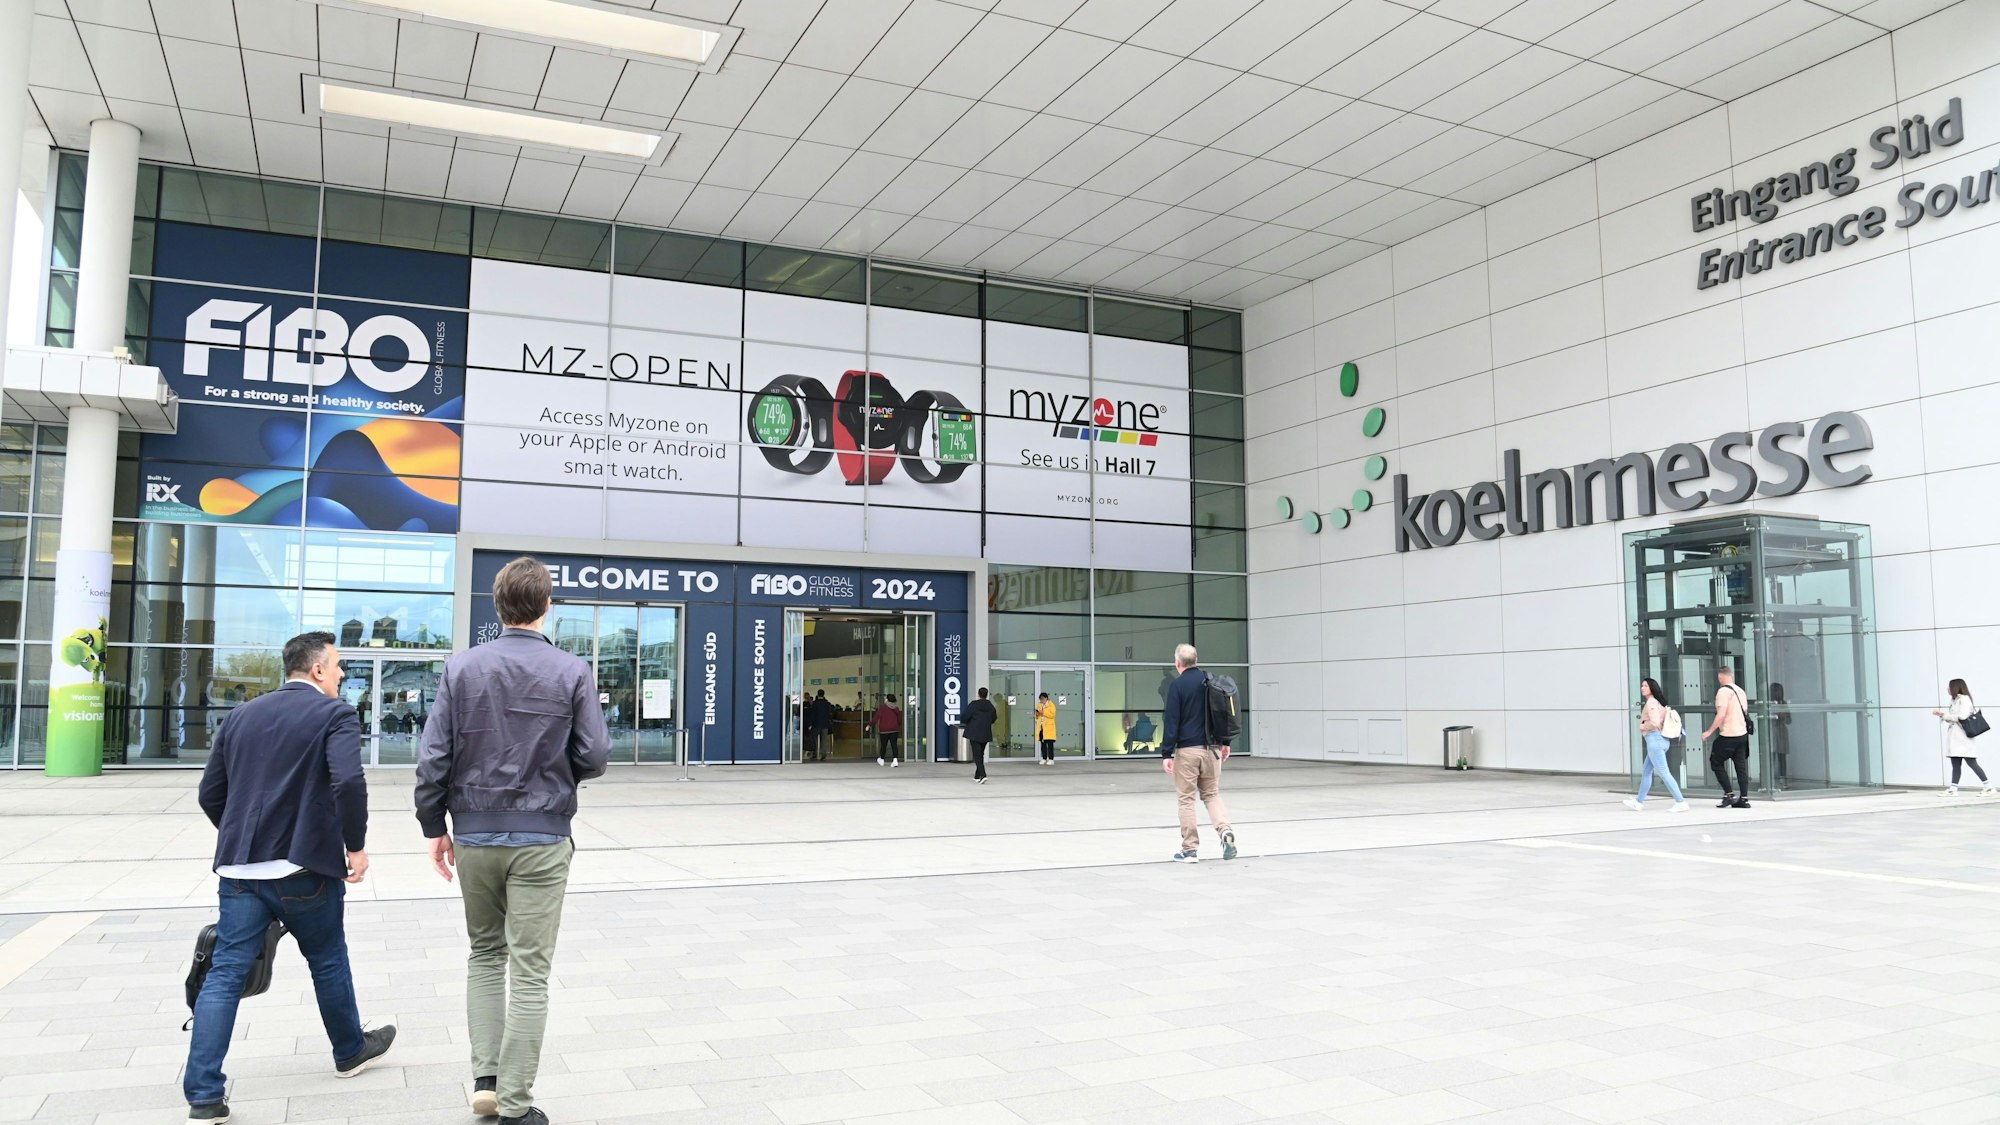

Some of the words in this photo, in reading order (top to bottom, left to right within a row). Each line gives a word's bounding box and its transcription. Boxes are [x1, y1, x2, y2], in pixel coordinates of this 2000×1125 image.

[1691, 148, 1859, 233] Eingang
[1870, 97, 1964, 170] Süd
[1697, 206, 1886, 290] Entrance
[183, 299, 431, 393] FIBO
[435, 321, 446, 357] FITNESS
[434, 358, 444, 395] GLOBAL
[521, 342, 731, 390] MZ-OPEN
[204, 385, 227, 397] For
[231, 388, 240, 399] a
[243, 390, 288, 404] strong
[292, 394, 319, 405] and
[322, 396, 373, 411] healthy
[376, 401, 425, 413] society.
[539, 407, 603, 427] Access
[609, 412, 680, 434] Myzone
[685, 422, 709, 434] on
[763, 403, 786, 425] 74%
[519, 432, 564, 449] your
[569, 433, 622, 455] Apple
[628, 440, 648, 452] or
[653, 440, 727, 459] Android
[948, 432, 967, 451] 74%
[623, 464, 683, 481] watch.
[1021, 448, 1053, 468] See
[1059, 454, 1079, 470] us
[1105, 456, 1140, 475] Hall
[1146, 460, 1156, 476] 7
[146, 483, 181, 503] RX
[1395, 411, 1874, 554] koelnmesse
[1057, 494, 1119, 506] MYZON.ORG
[677, 570, 719, 593] TO
[751, 573, 807, 596] FIBO
[808, 575, 854, 587] GLOBAL
[809, 587, 854, 598] FITNESS
[871, 578, 936, 601] 2024
[703, 631, 717, 661] SÜD
[754, 619, 766, 665] SOUTH
[944, 634, 952, 676] GLOBAL
[952, 634, 961, 675] FITNESS
[704, 664, 716, 725] EINGANG
[753, 667, 765, 740] ENTRANCE
[944, 676, 961, 727] FIBO
